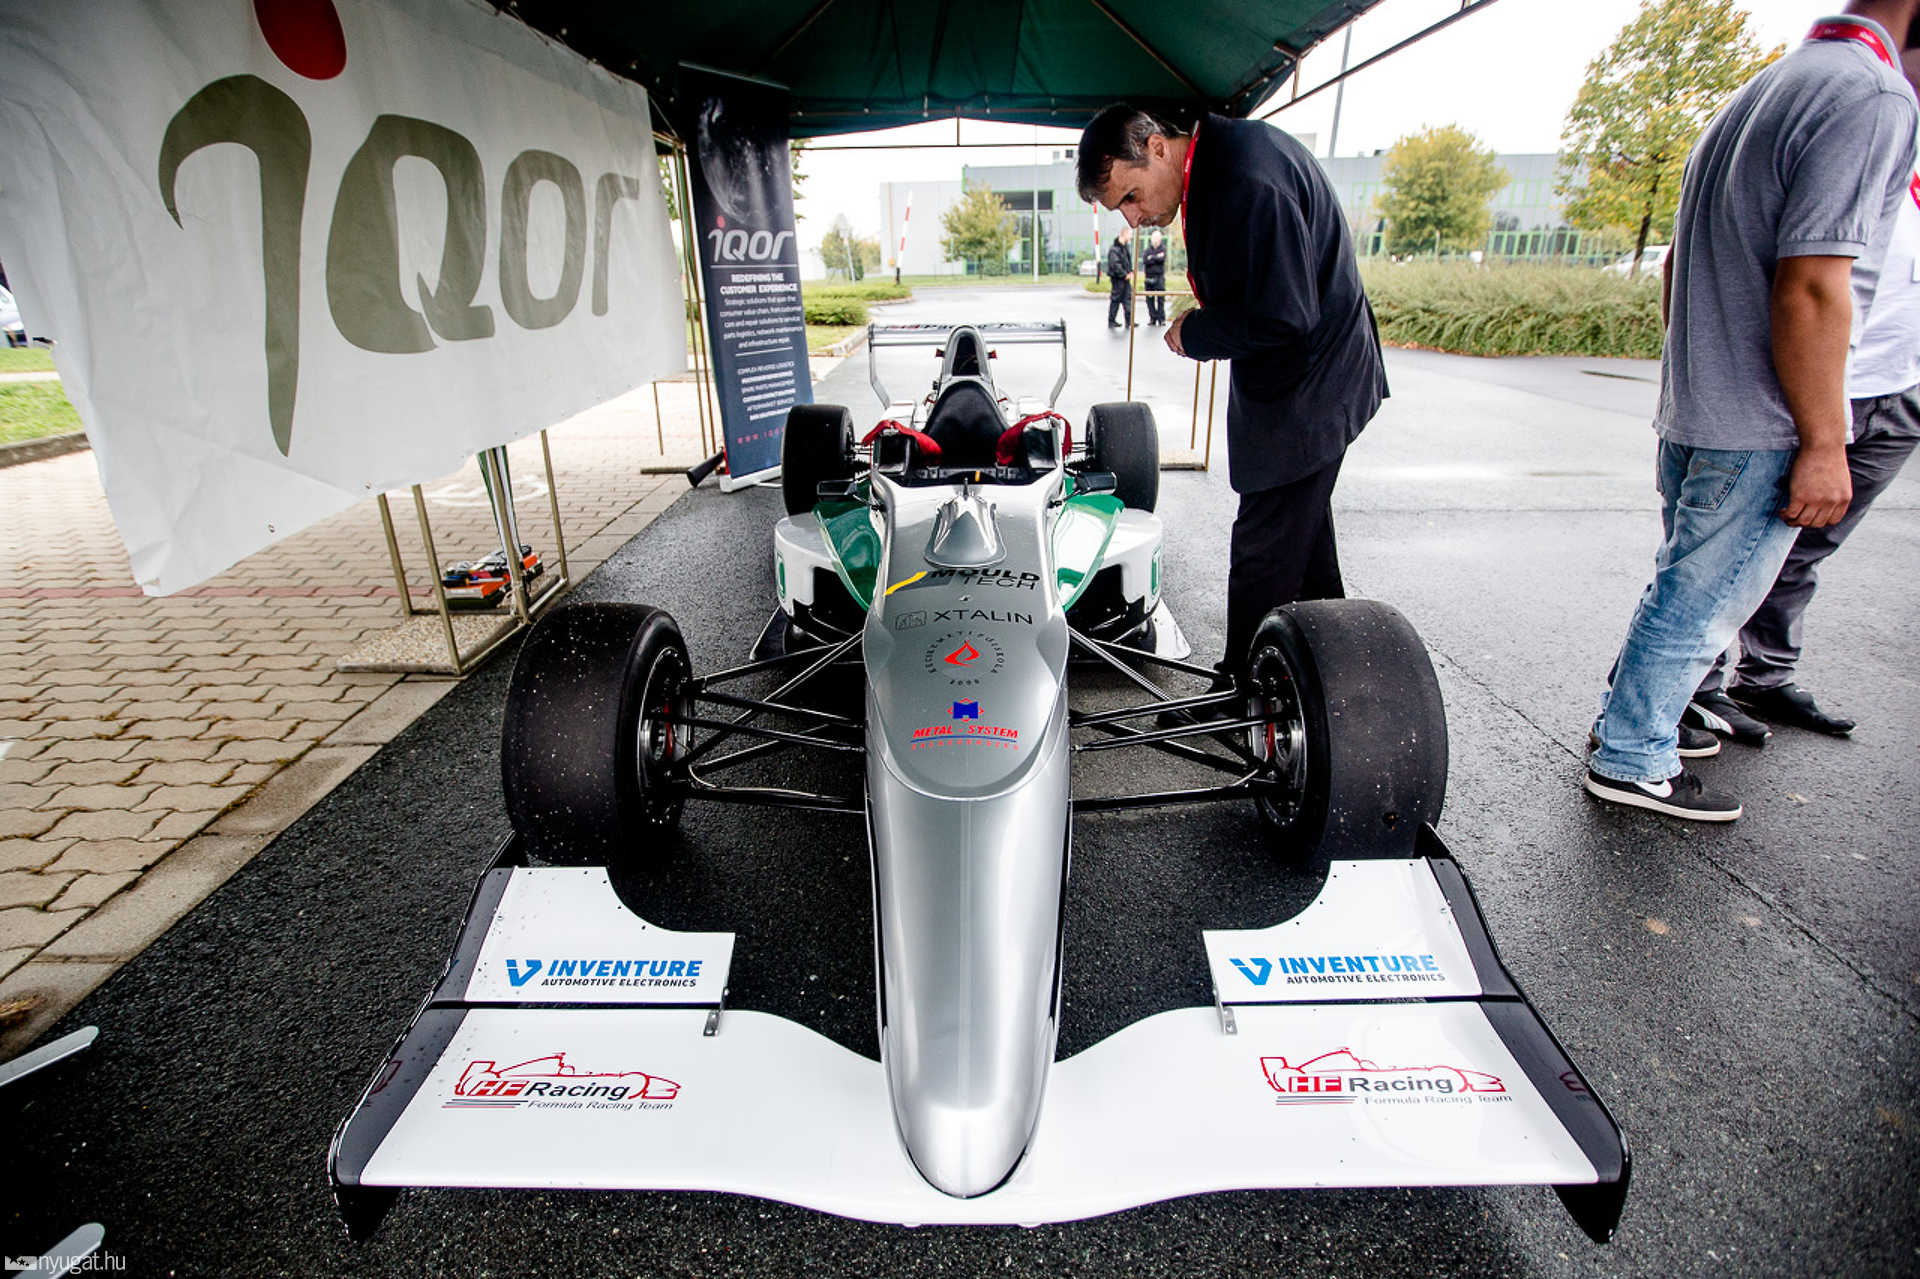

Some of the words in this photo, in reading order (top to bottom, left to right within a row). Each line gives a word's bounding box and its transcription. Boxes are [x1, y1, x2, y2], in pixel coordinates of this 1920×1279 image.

[771, 272, 784, 282] THE
[720, 285, 757, 295] CUSTOMER
[758, 283, 798, 294] EXPERIENCE
[931, 567, 1041, 582] MOULD
[963, 577, 1037, 590] TECH
[934, 609, 1034, 625] XTALIN
[912, 724, 953, 739] METAL
[967, 724, 1019, 739] SYSTEM
[547, 959, 704, 978] INVENTURE
[1278, 953, 1440, 975] INVENTURE
[541, 978, 617, 987] AUTOMOTIVE
[618, 978, 697, 988] ELECTRONICS
[1286, 974, 1364, 985] AUTOMOTIVE
[1365, 972, 1447, 984] ELECTRONICS
[1349, 1074, 1454, 1094] Racing
[527, 1100, 583, 1111] Formula
[586, 1101, 633, 1112] Racing
[638, 1101, 674, 1111] Team
[1364, 1096, 1421, 1105] Formula
[1424, 1096, 1473, 1105] Racing
[1478, 1094, 1514, 1104] Team
